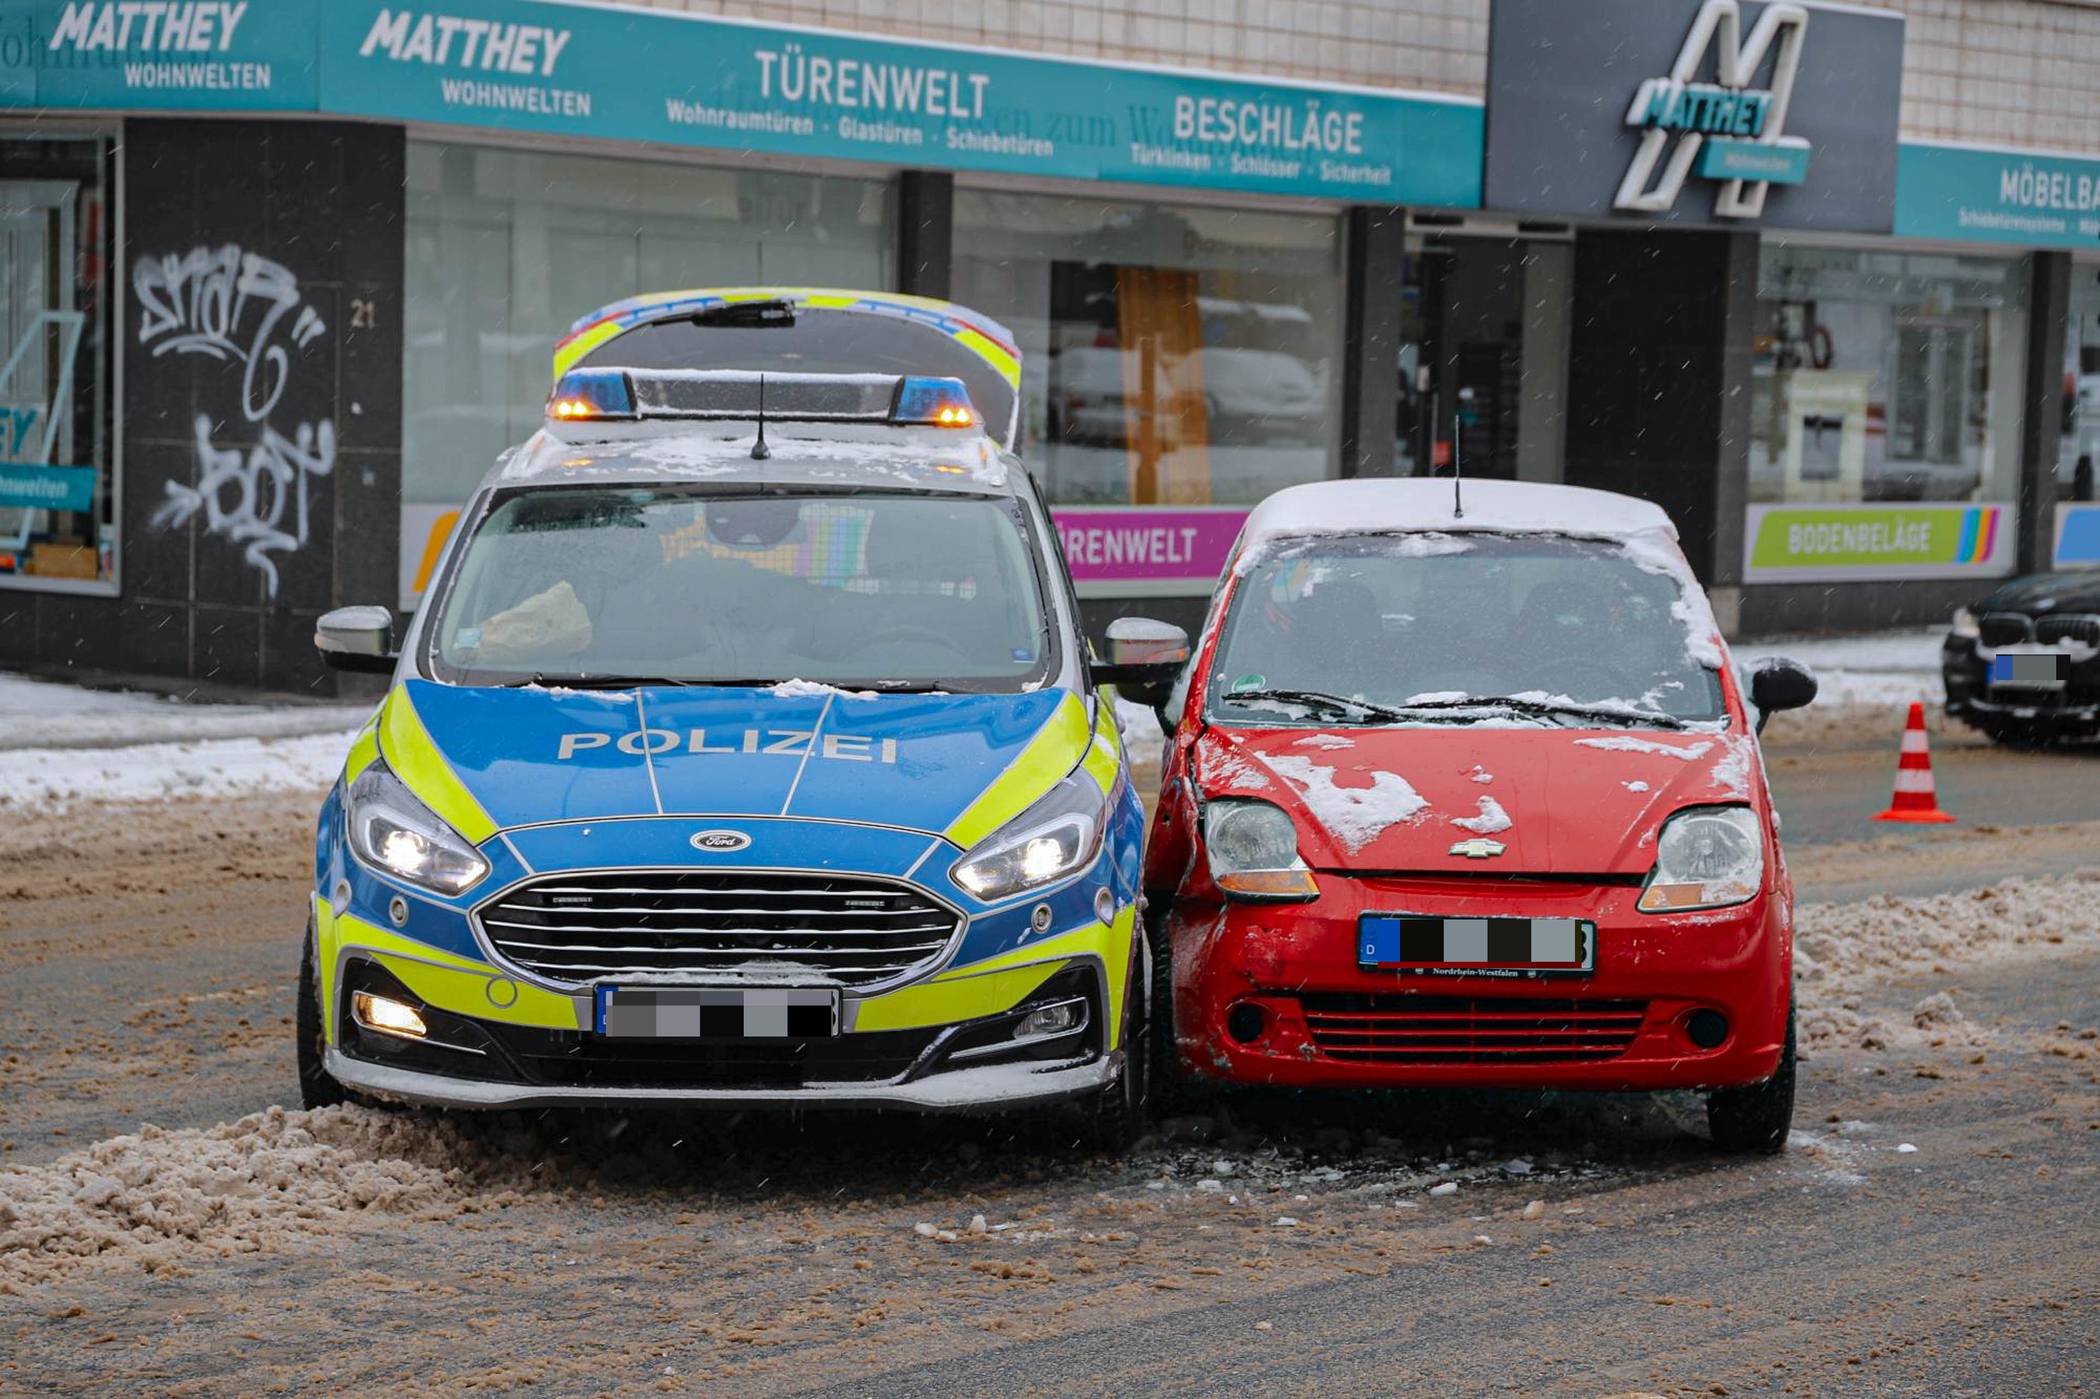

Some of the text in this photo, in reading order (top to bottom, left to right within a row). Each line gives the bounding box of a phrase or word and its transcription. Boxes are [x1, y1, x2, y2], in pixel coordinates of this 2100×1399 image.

[49, 0, 248, 51] MATTHEY
[358, 8, 571, 77] MATTHEY
[124, 62, 271, 89] WOHNWELTEN
[754, 43, 990, 119] TÜRENWELT
[440, 78, 592, 117] WOHNWELTEN
[1625, 76, 1775, 136] MATTHEY
[665, 99, 1055, 158] Wohnraumtüren Glastüren Schiebetüren
[1173, 96, 1364, 154] BESCHLÄGE
[1130, 143, 1392, 186] Türklinken Schlösser Sicherheit
[351, 299, 375, 329] 21
[1060, 522, 1196, 565] RENWELT
[1788, 512, 1932, 554] BODENBELÄGE
[558, 729, 896, 764] POLIZEI
[706, 835, 736, 846] Ford
[1433, 967, 1518, 977] Nordrhein-Westfalen
